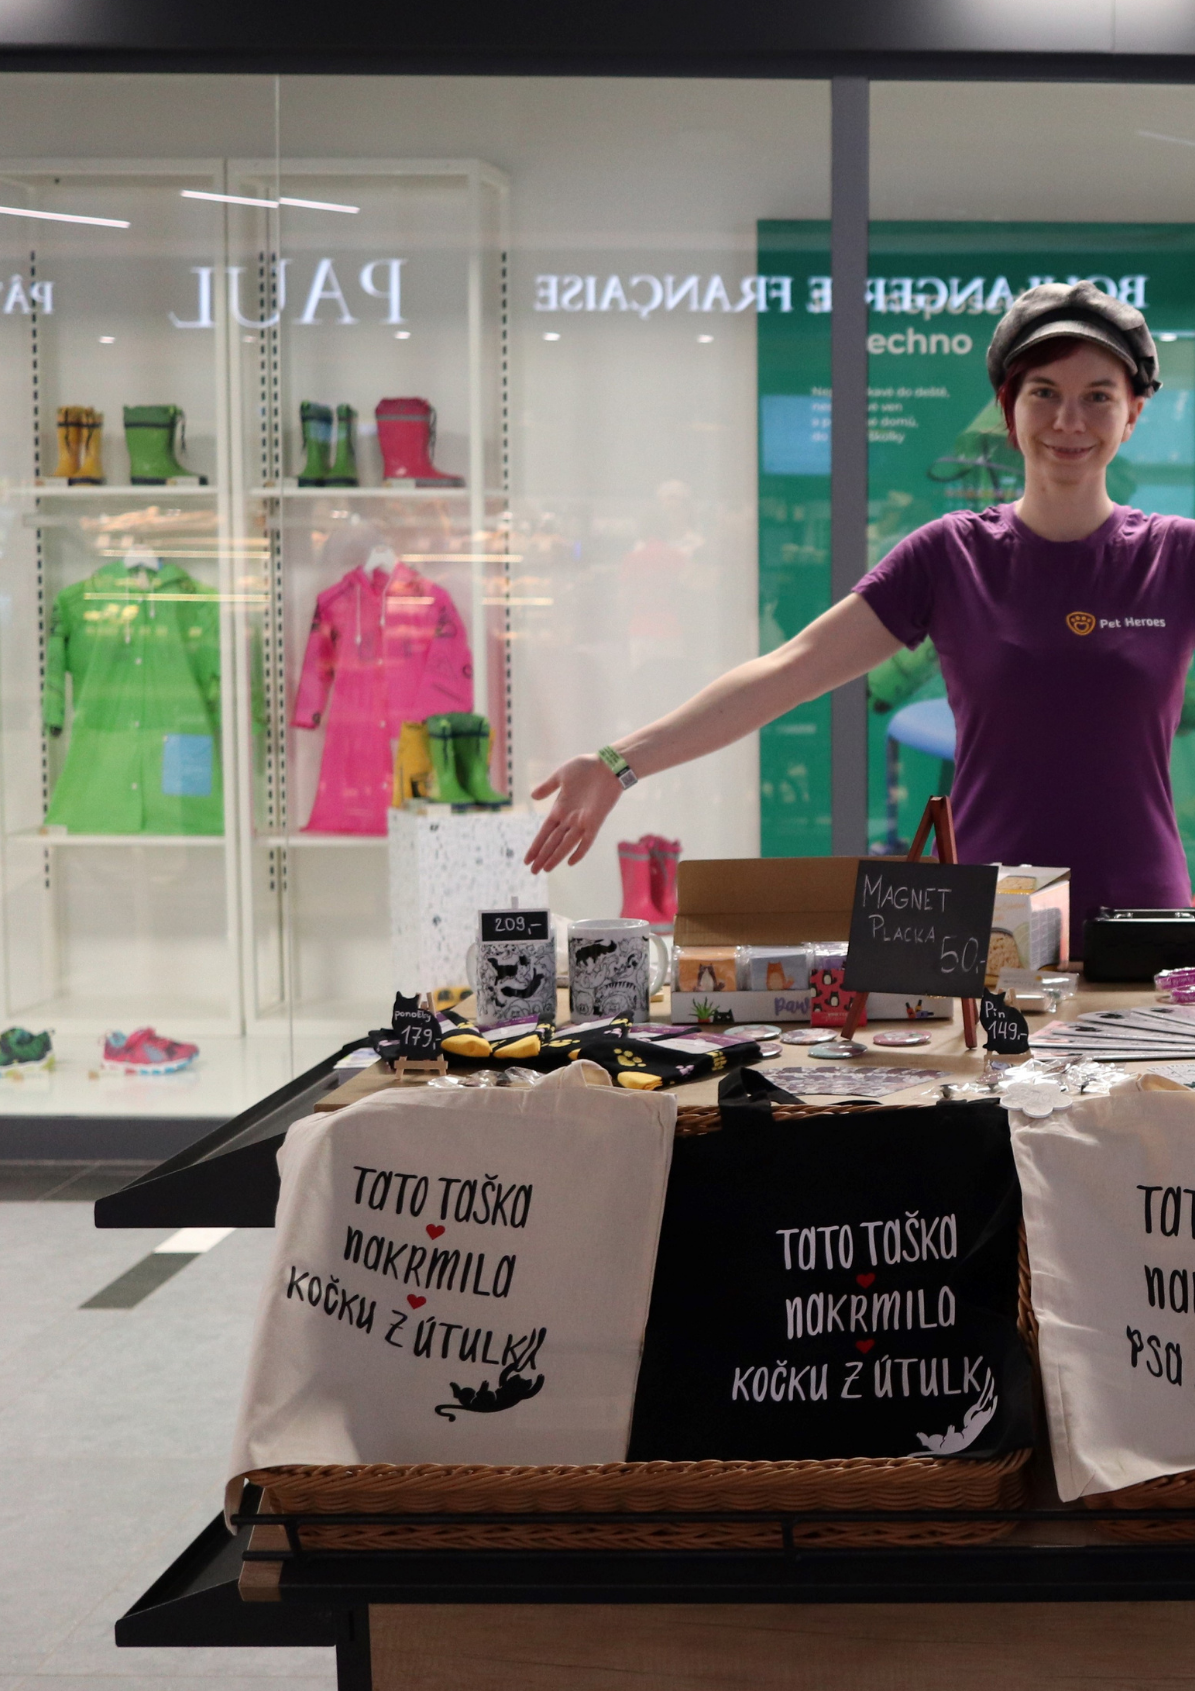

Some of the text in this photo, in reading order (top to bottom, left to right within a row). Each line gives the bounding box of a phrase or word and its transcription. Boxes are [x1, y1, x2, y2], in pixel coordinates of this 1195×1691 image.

[1099, 616, 1167, 630] Pet Heroes
[862, 874, 953, 913] MAGNET
[868, 913, 936, 944] PLACKA
[985, 1000, 1006, 1019] Pin
[384, 1309, 408, 1348] Z
[840, 1361, 864, 1399] Z
